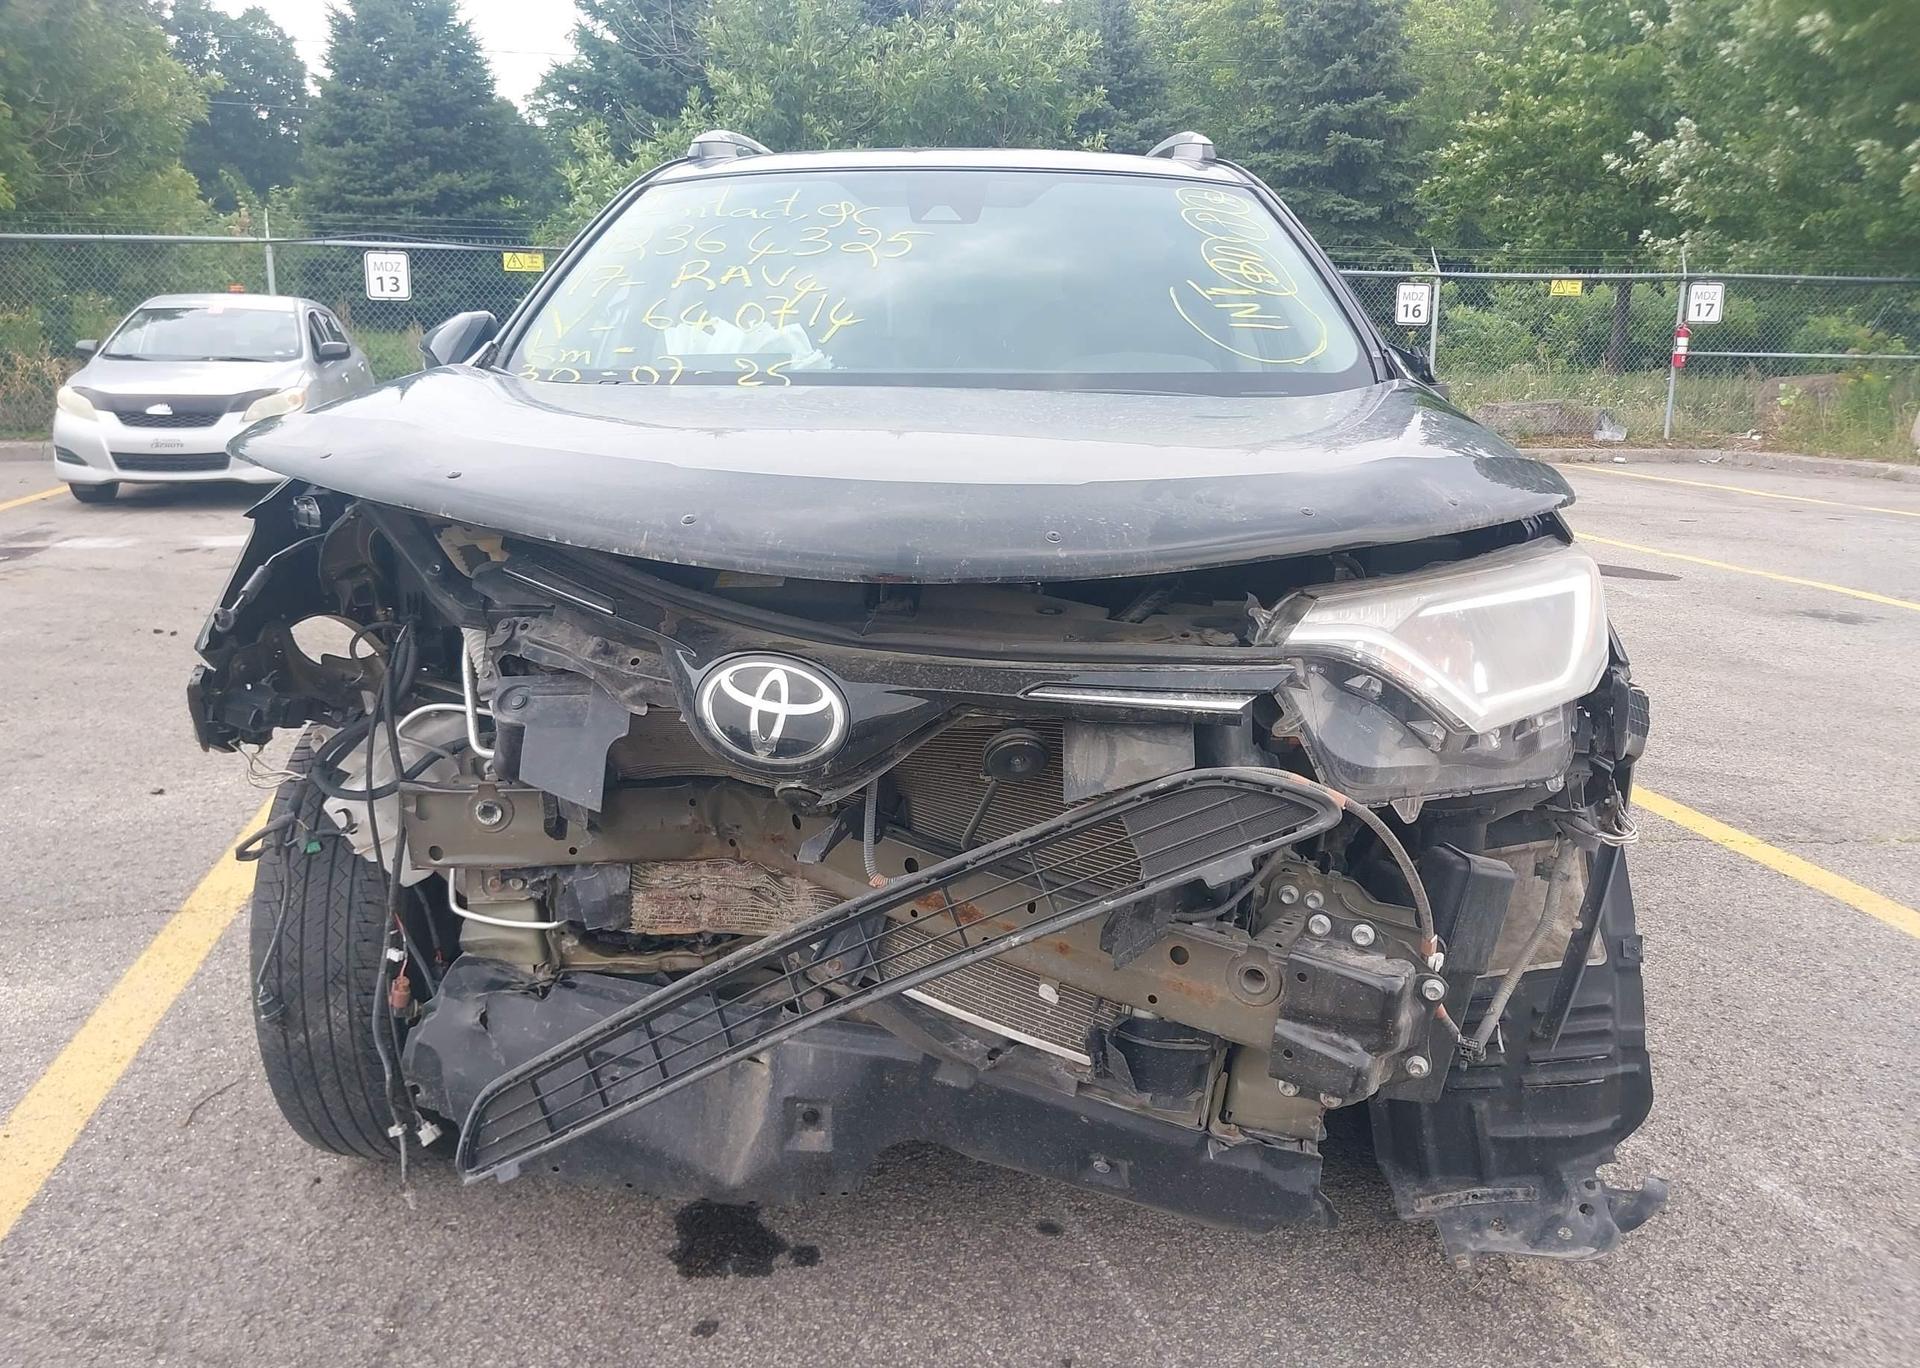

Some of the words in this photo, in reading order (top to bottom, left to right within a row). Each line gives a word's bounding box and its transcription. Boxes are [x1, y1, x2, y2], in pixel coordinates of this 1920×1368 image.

[373, 261, 401, 272] MDZ
[376, 276, 400, 292] 13
[670, 259, 828, 309] RAV4
[1403, 291, 1424, 301] MDZ
[1695, 291, 1717, 301] MDZ
[1403, 303, 1421, 318] 16
[1695, 303, 1715, 317] 17
